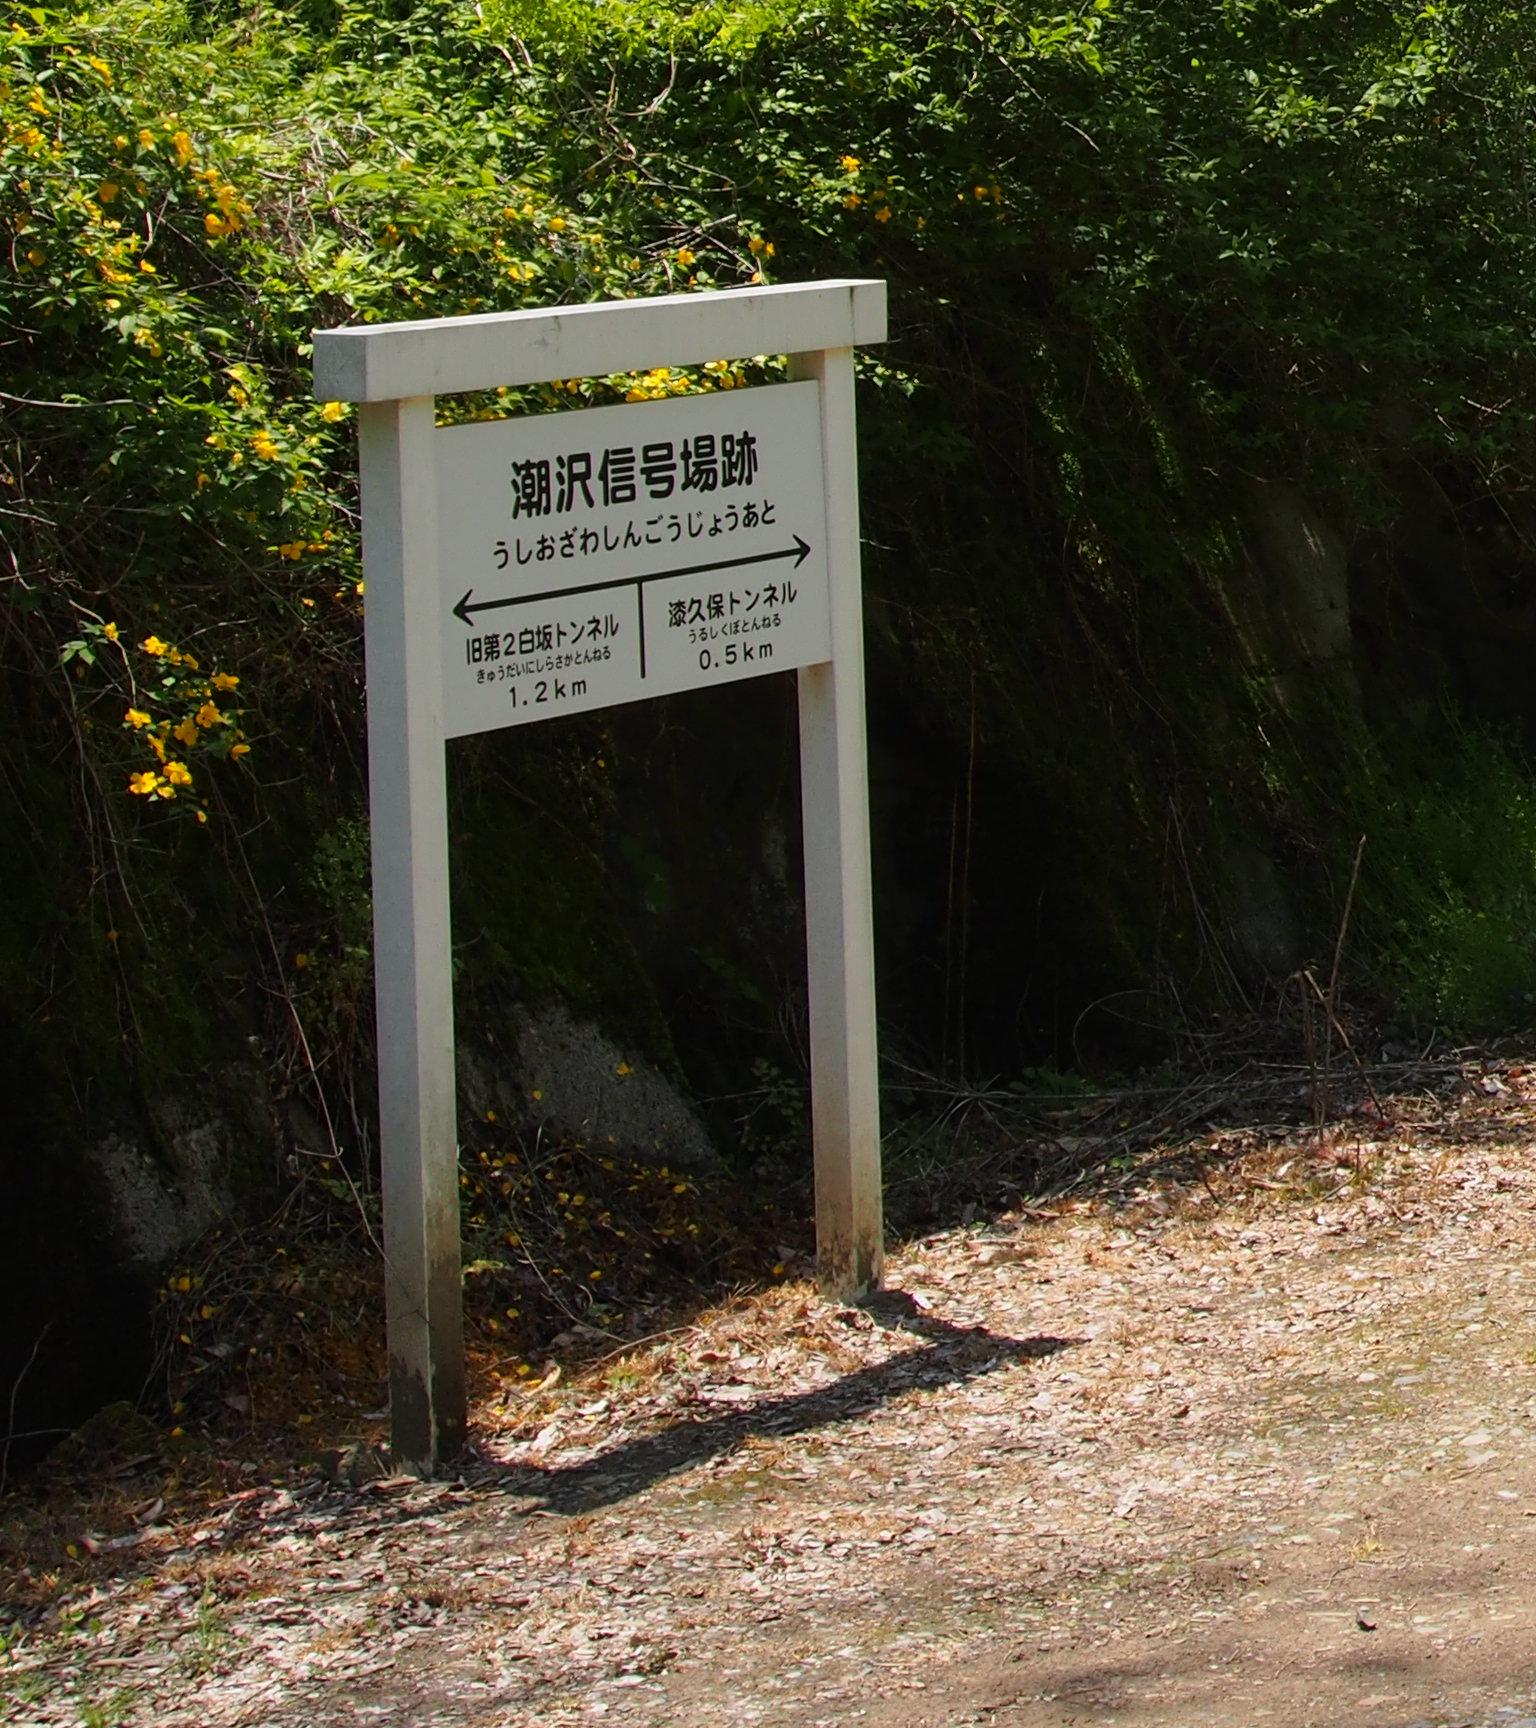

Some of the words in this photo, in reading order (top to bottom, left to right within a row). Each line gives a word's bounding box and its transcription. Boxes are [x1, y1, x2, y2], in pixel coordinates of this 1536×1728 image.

[511, 431, 758, 519] 潮沢信号場跡
[493, 499, 775, 569] うしおざわしんごうじょうあと
[668, 581, 797, 628] 漆久保トンネル
[466, 613, 619, 665] 旧第2白坂トンネル
